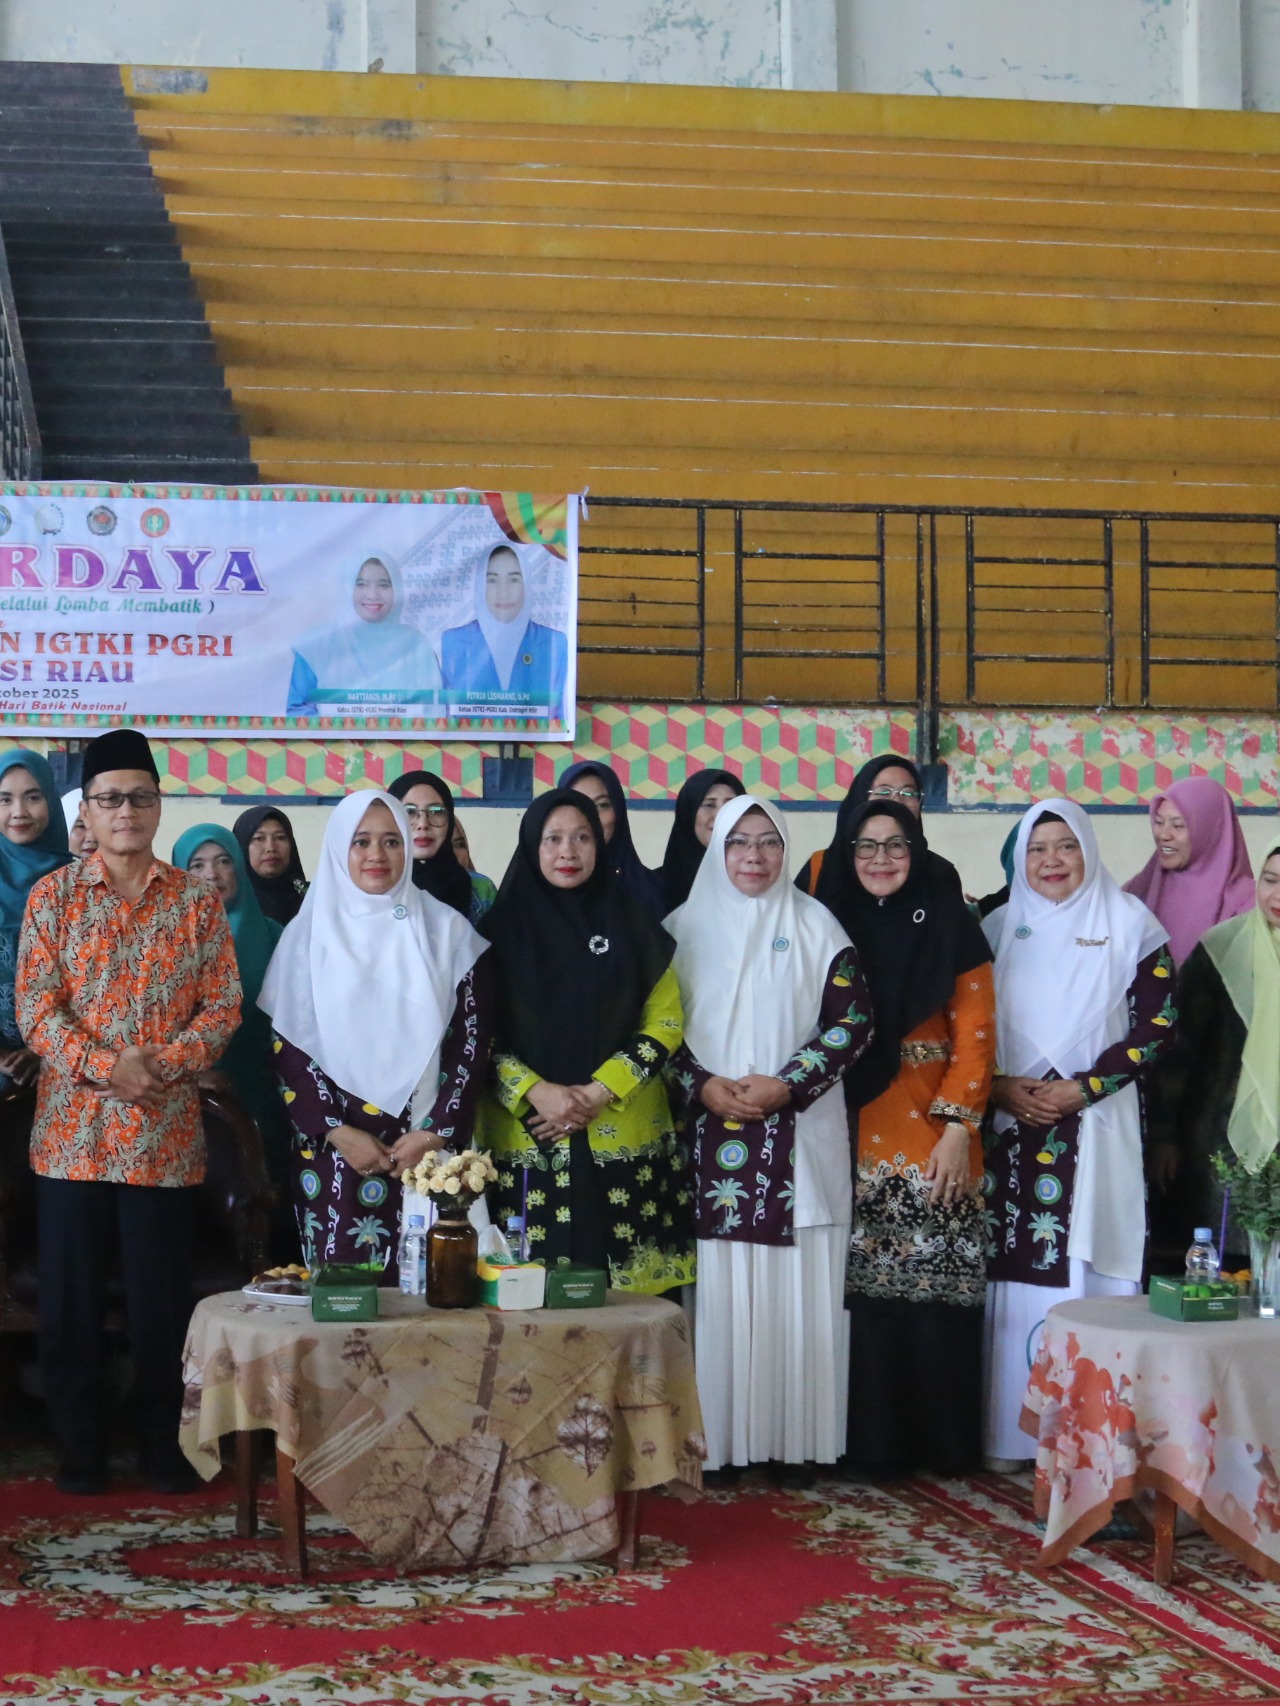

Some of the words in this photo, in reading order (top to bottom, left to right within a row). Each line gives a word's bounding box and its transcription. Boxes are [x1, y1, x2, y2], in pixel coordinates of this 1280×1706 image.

[54, 595, 110, 614] Lomba
[116, 598, 203, 613] Membatik
[35, 632, 133, 655] IGTKI
[147, 634, 234, 657] PGRI
[46, 660, 135, 683] RIAU
[42, 688, 80, 699] 2025
[31, 700, 66, 711] Batik
[71, 701, 128, 712] Nasional
